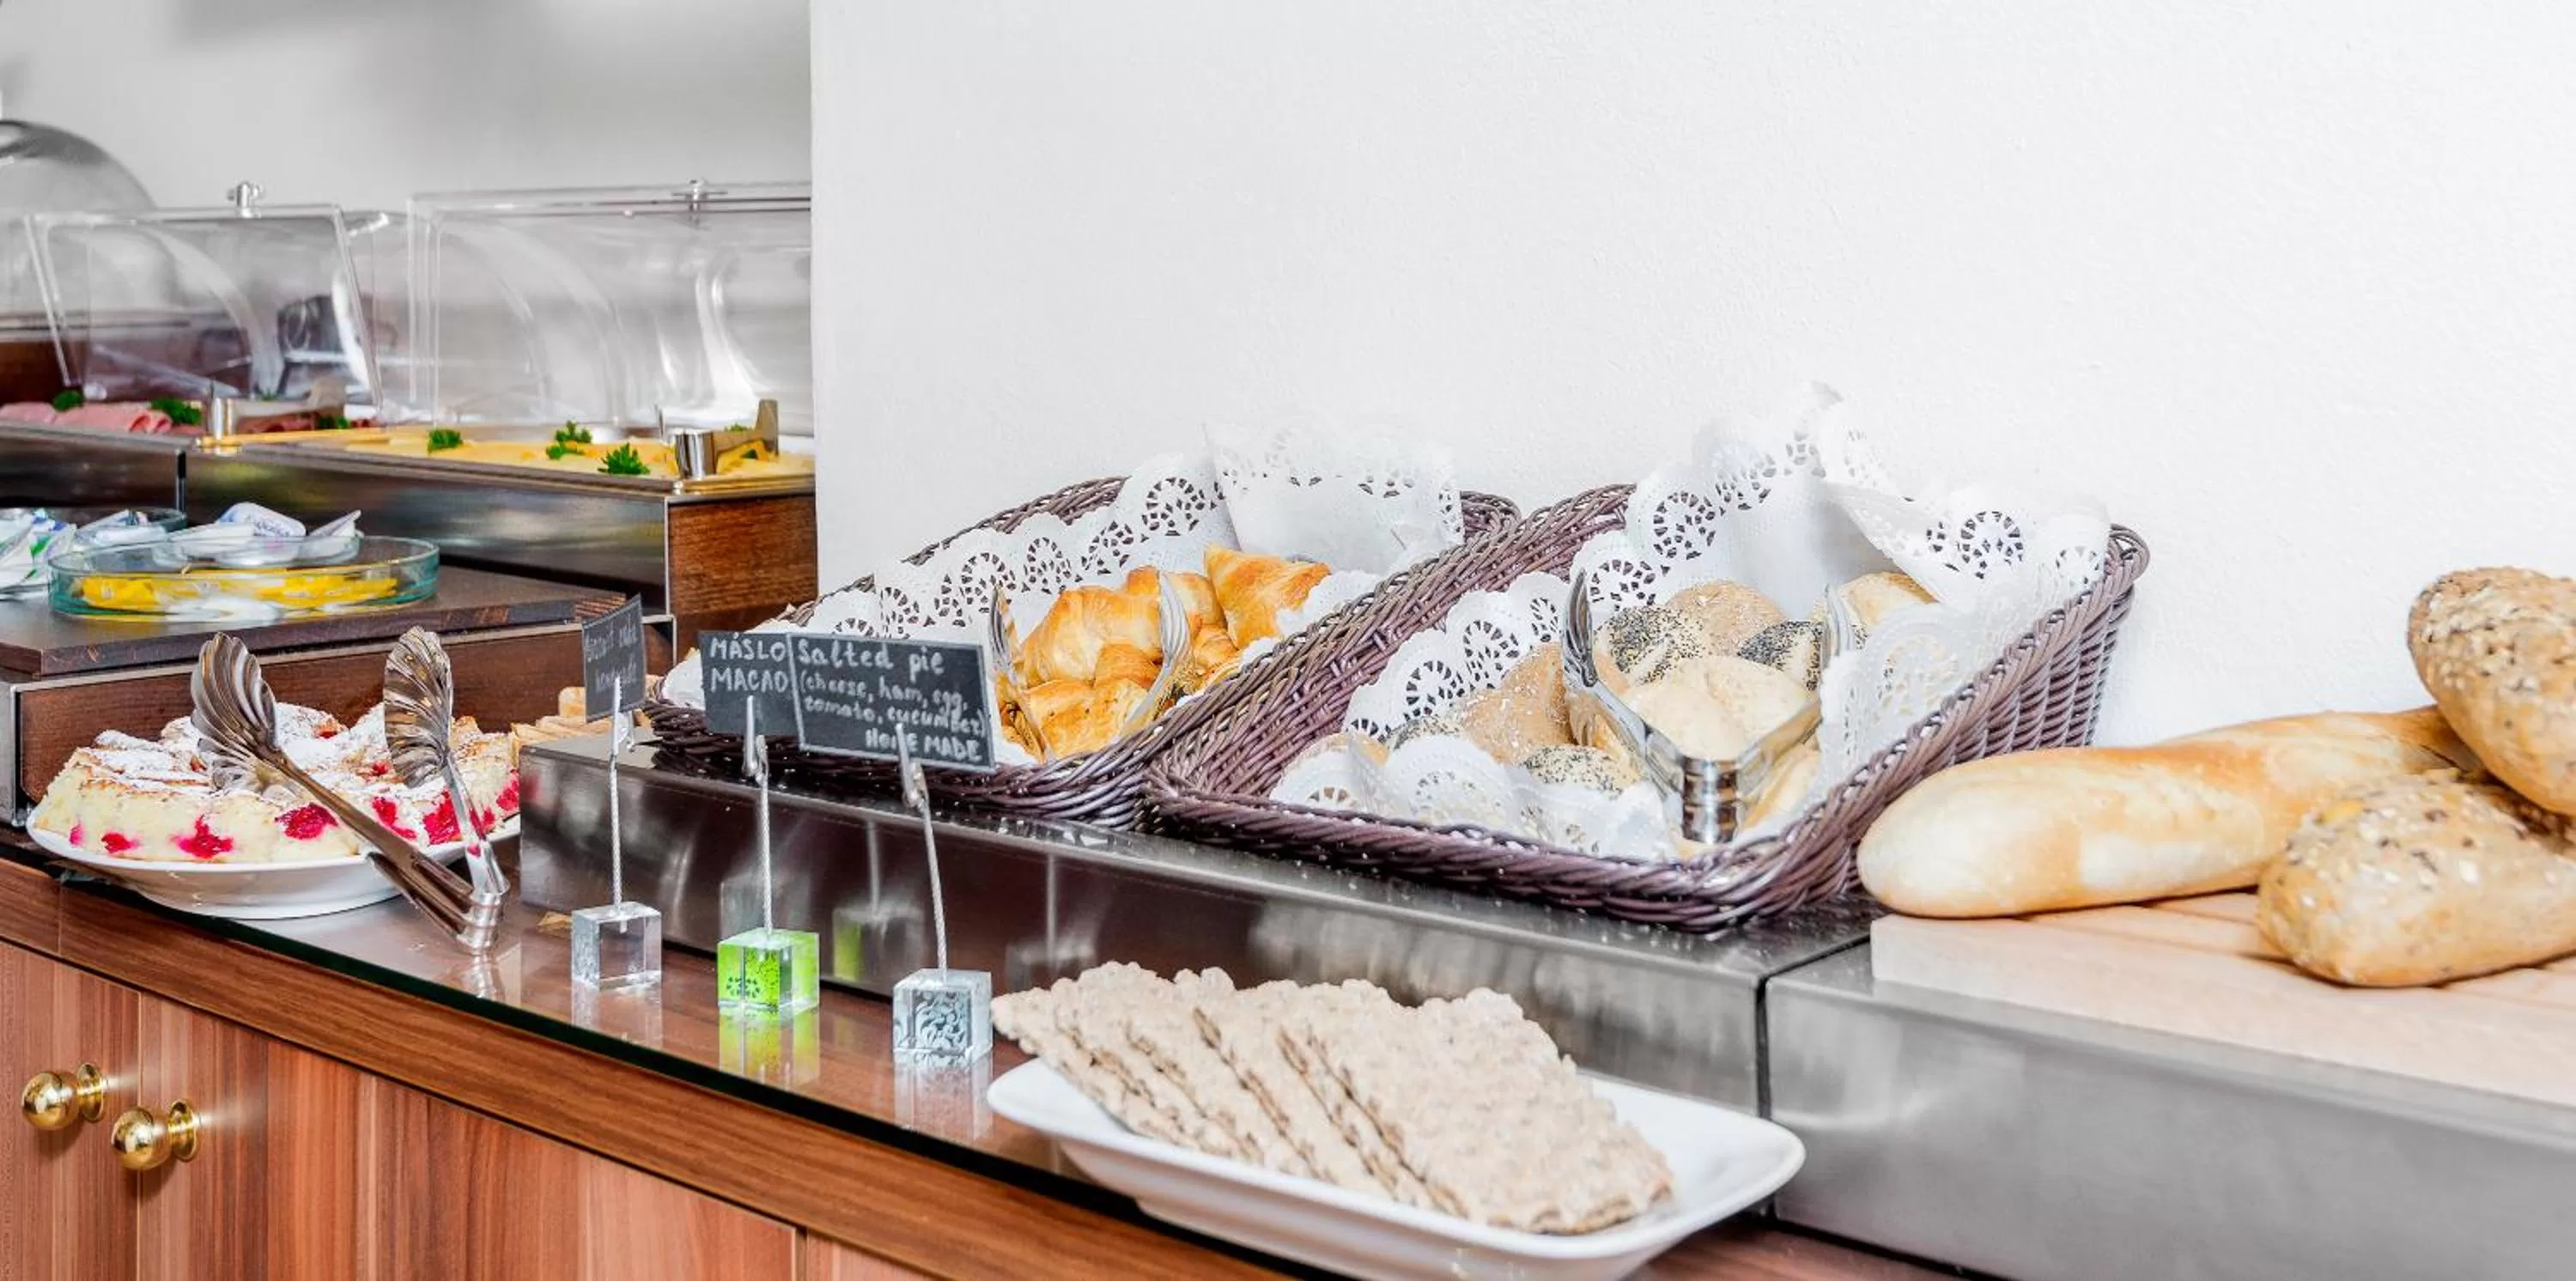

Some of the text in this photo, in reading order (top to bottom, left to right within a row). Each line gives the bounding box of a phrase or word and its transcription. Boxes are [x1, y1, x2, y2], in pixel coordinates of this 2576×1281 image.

[710, 632, 786, 663] MÁSLO
[797, 639, 944, 683] Salted pie
[710, 667, 789, 693] MACAO
[799, 670, 874, 703] (cheese,
[878, 676, 927, 708] ham,
[804, 695, 883, 725] tomato,
[924, 735, 982, 762] MADE
